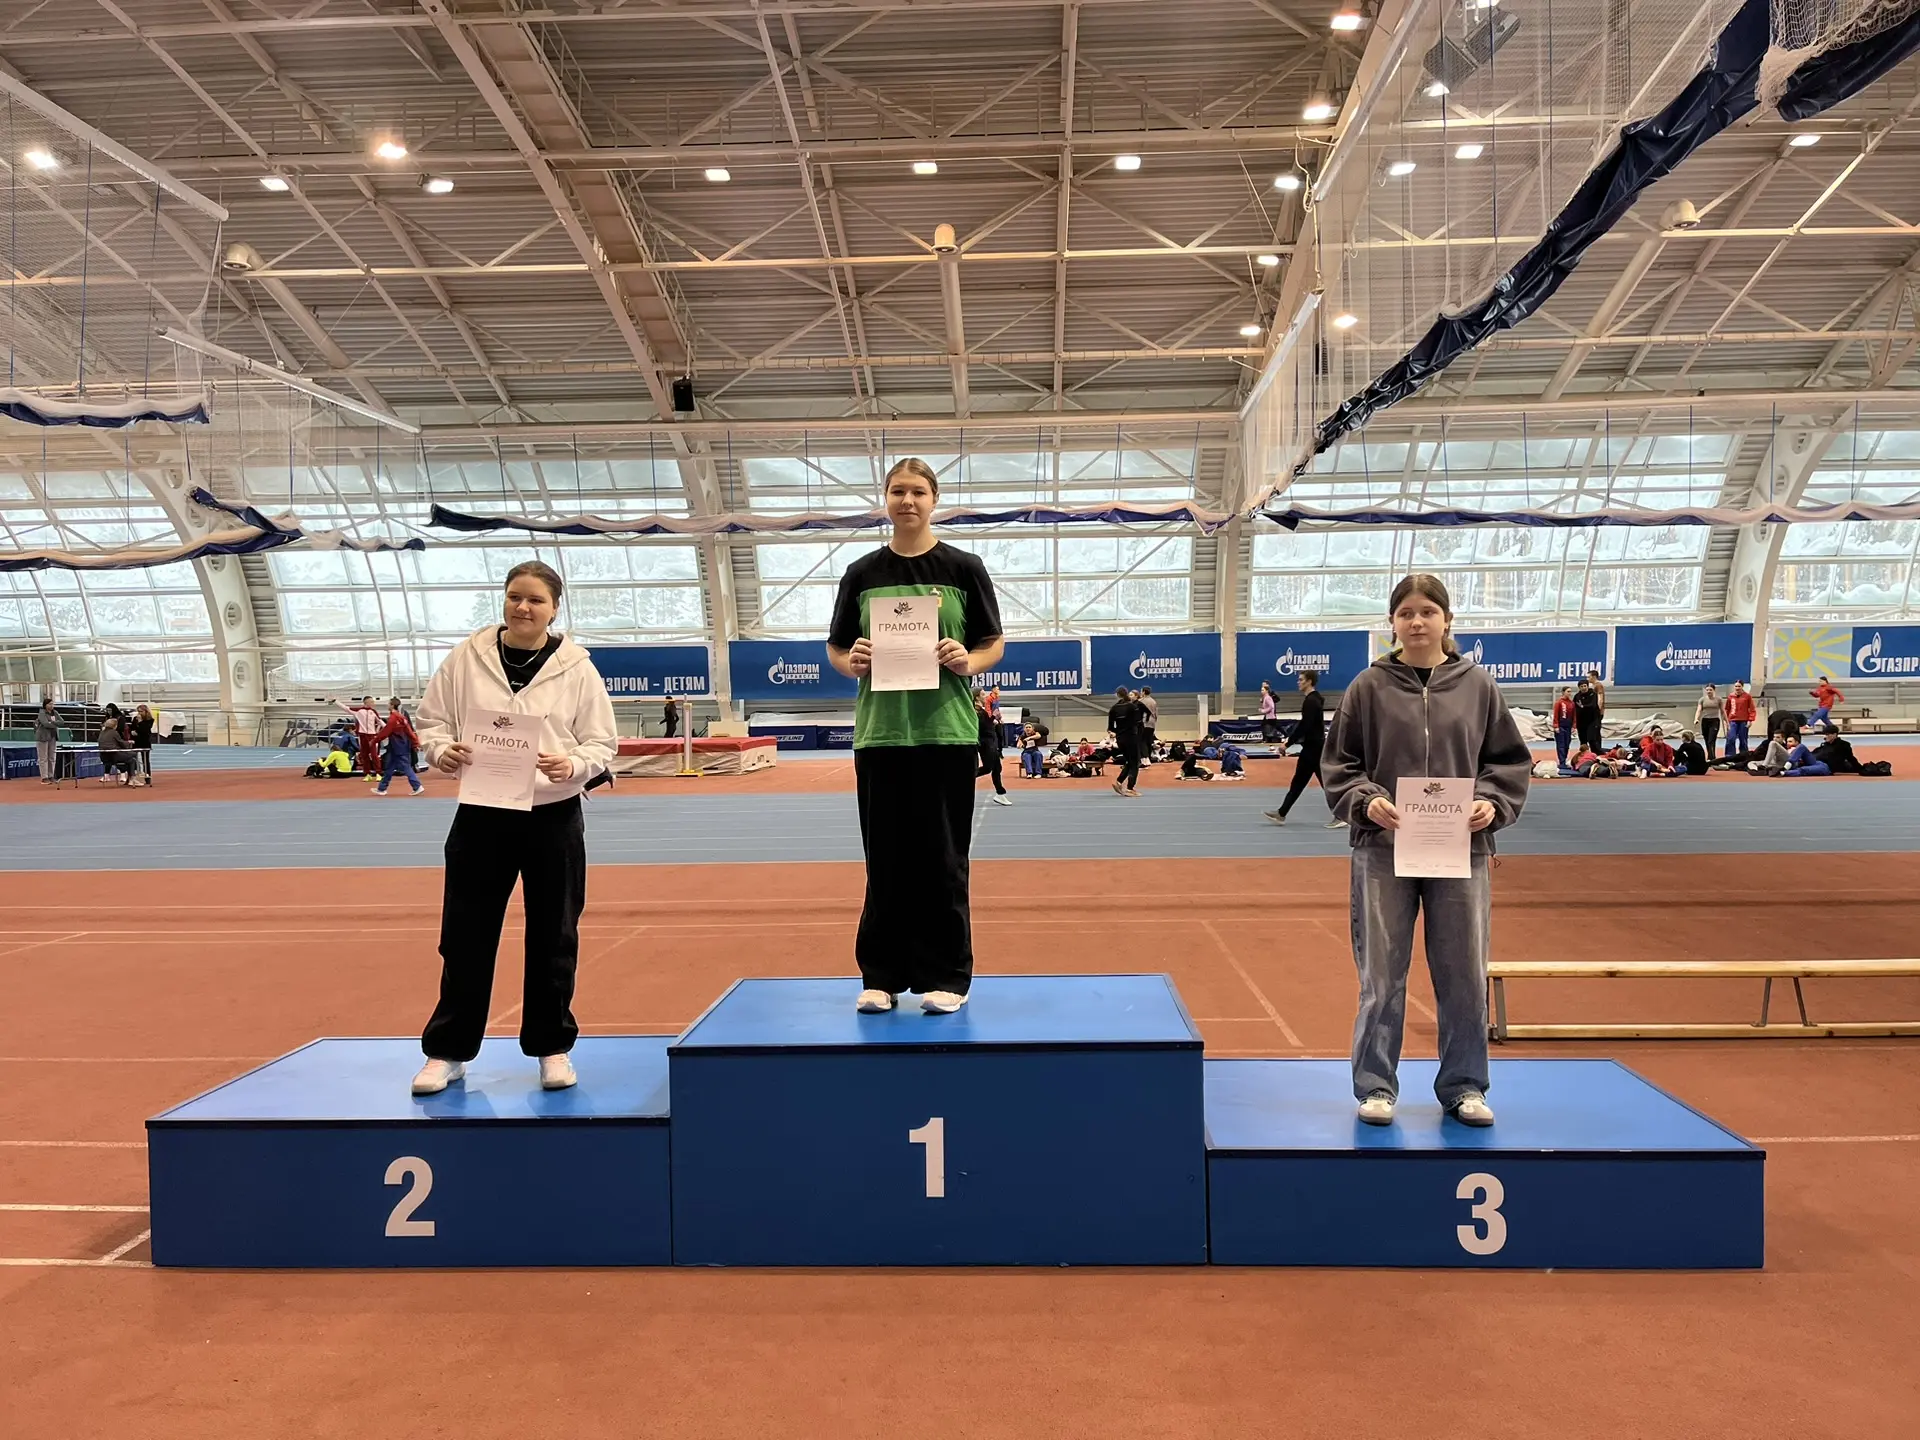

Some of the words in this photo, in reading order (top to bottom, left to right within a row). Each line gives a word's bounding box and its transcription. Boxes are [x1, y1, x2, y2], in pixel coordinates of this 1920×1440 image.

[878, 622, 930, 632] ГРАМОТА
[1294, 655, 1329, 664] ГАЗПРОМ
[1674, 649, 1711, 659] ГАЗПРОМ
[785, 664, 819, 673] ГАЗПРОМ
[1147, 658, 1182, 667] ГАЗПРОМ
[1881, 657, 1920, 672] ГАЗПР
[1557, 662, 1601, 679] ДЕТЯМ
[602, 677, 648, 691] ЗПРОМ
[664, 676, 705, 693] ДЕТЯМ
[971, 672, 1020, 687] АЗПРОМ
[1036, 671, 1078, 687] ДЕТЯМ
[474, 734, 529, 749] ГРАМОТА
[1404, 803, 1463, 814] ГРАМОТА
[908, 1117, 945, 1198] 1
[384, 1156, 435, 1237] 2
[1456, 1172, 1508, 1255] 3
